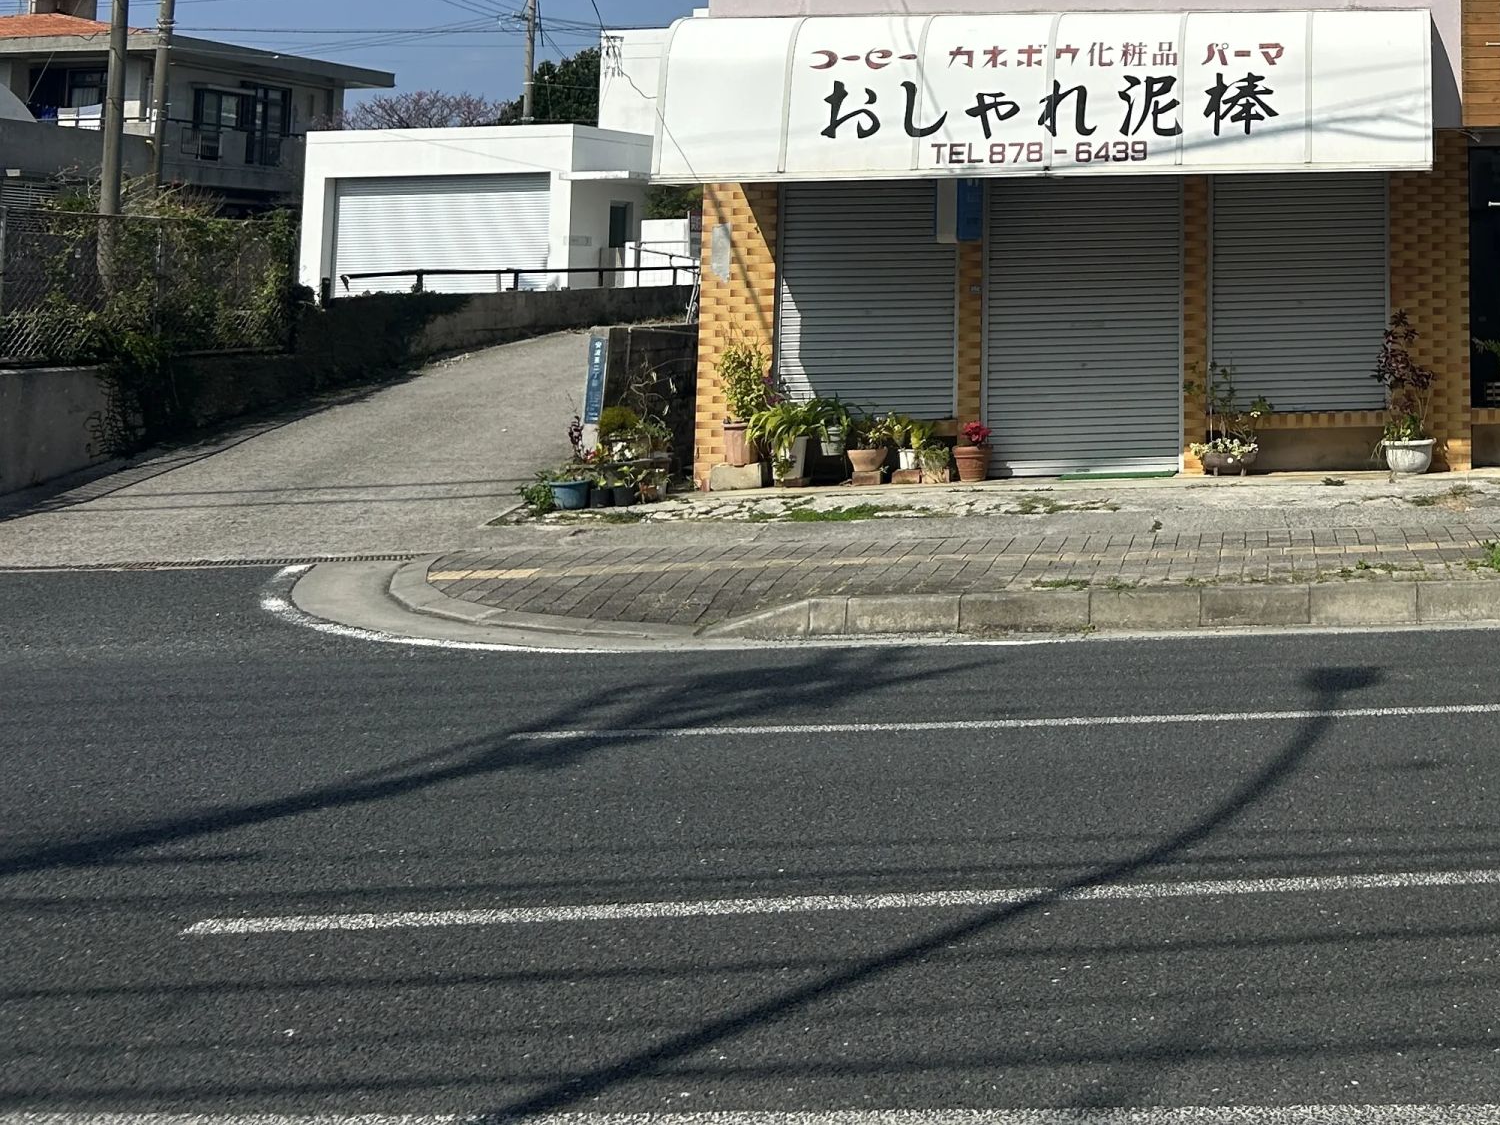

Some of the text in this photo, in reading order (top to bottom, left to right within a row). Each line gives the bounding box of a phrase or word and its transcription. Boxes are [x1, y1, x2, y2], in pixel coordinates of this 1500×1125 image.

[948, 41, 1180, 68] カネボウ化粧品
[1201, 41, 1286, 66] パーマ
[820, 72, 1280, 140] おしゃれ泥棒
